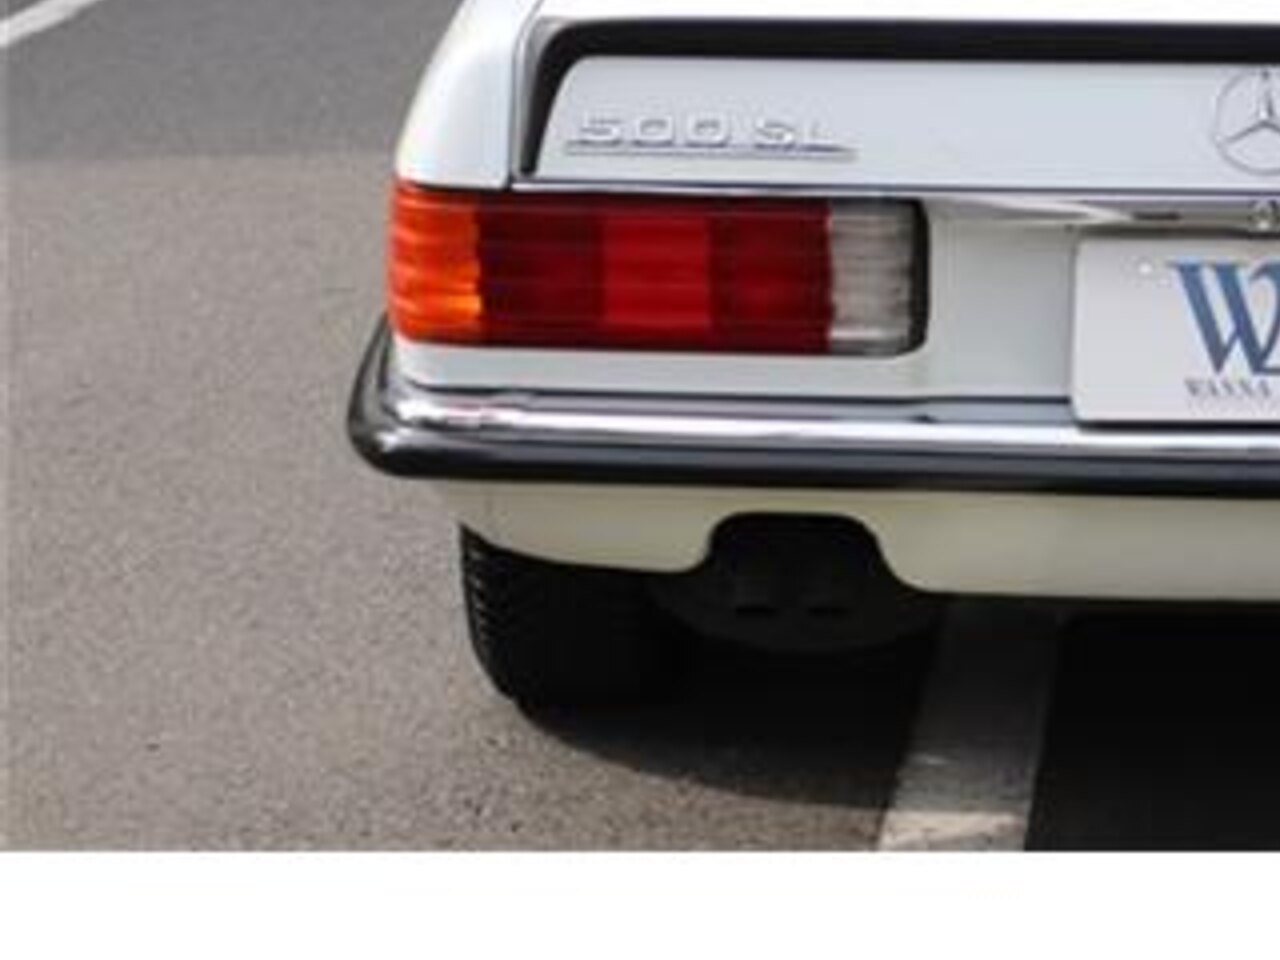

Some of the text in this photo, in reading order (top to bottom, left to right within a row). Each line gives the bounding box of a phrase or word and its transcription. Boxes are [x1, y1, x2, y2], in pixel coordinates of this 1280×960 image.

[576, 116, 842, 151] 500 SL
[1184, 379, 1271, 397] WANNA
